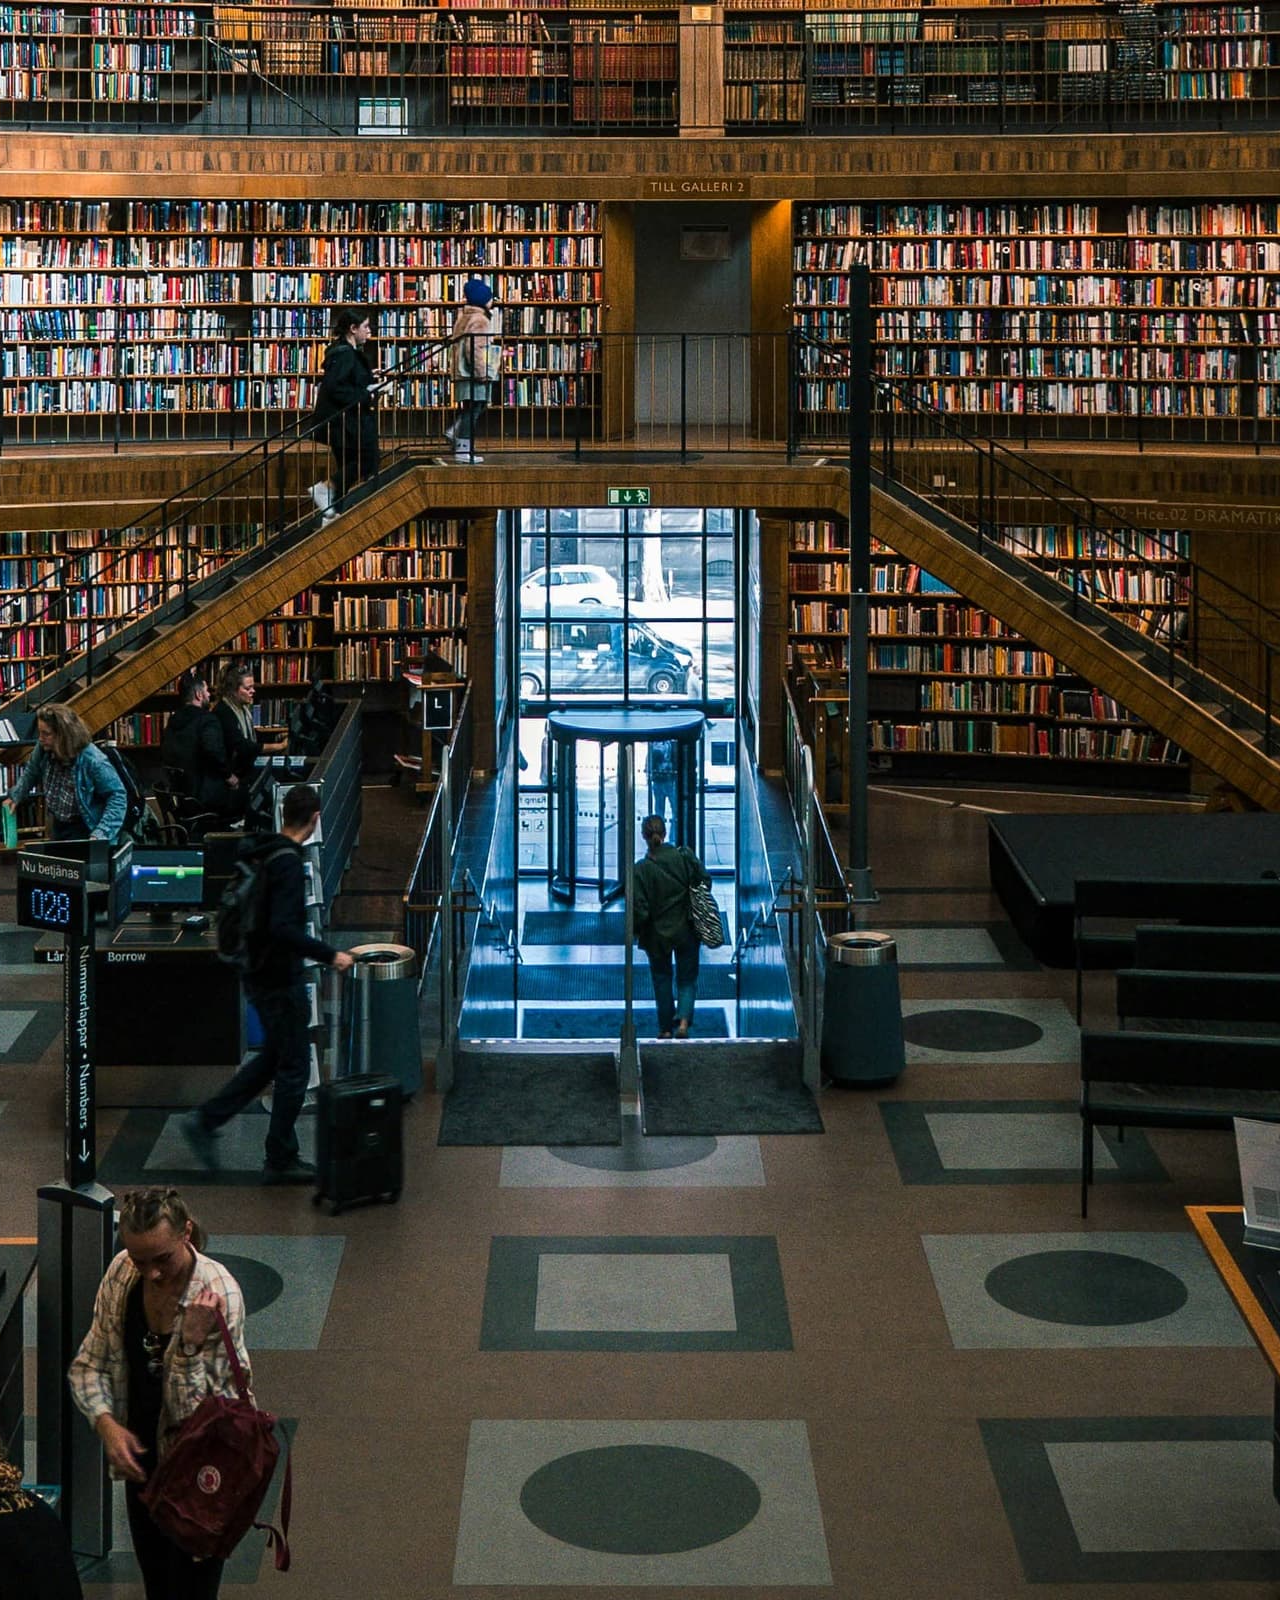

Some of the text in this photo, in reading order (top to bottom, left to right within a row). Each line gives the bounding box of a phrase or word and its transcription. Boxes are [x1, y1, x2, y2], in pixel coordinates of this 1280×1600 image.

[650, 181, 745, 192] TILL GALLERI 2
[434, 697, 443, 709] L
[22, 859, 80, 880] Nu betjänas
[31, 888, 70, 924] 028
[107, 951, 146, 962] Borrow
[76, 945, 90, 1130] Nummerlappar Numbers
